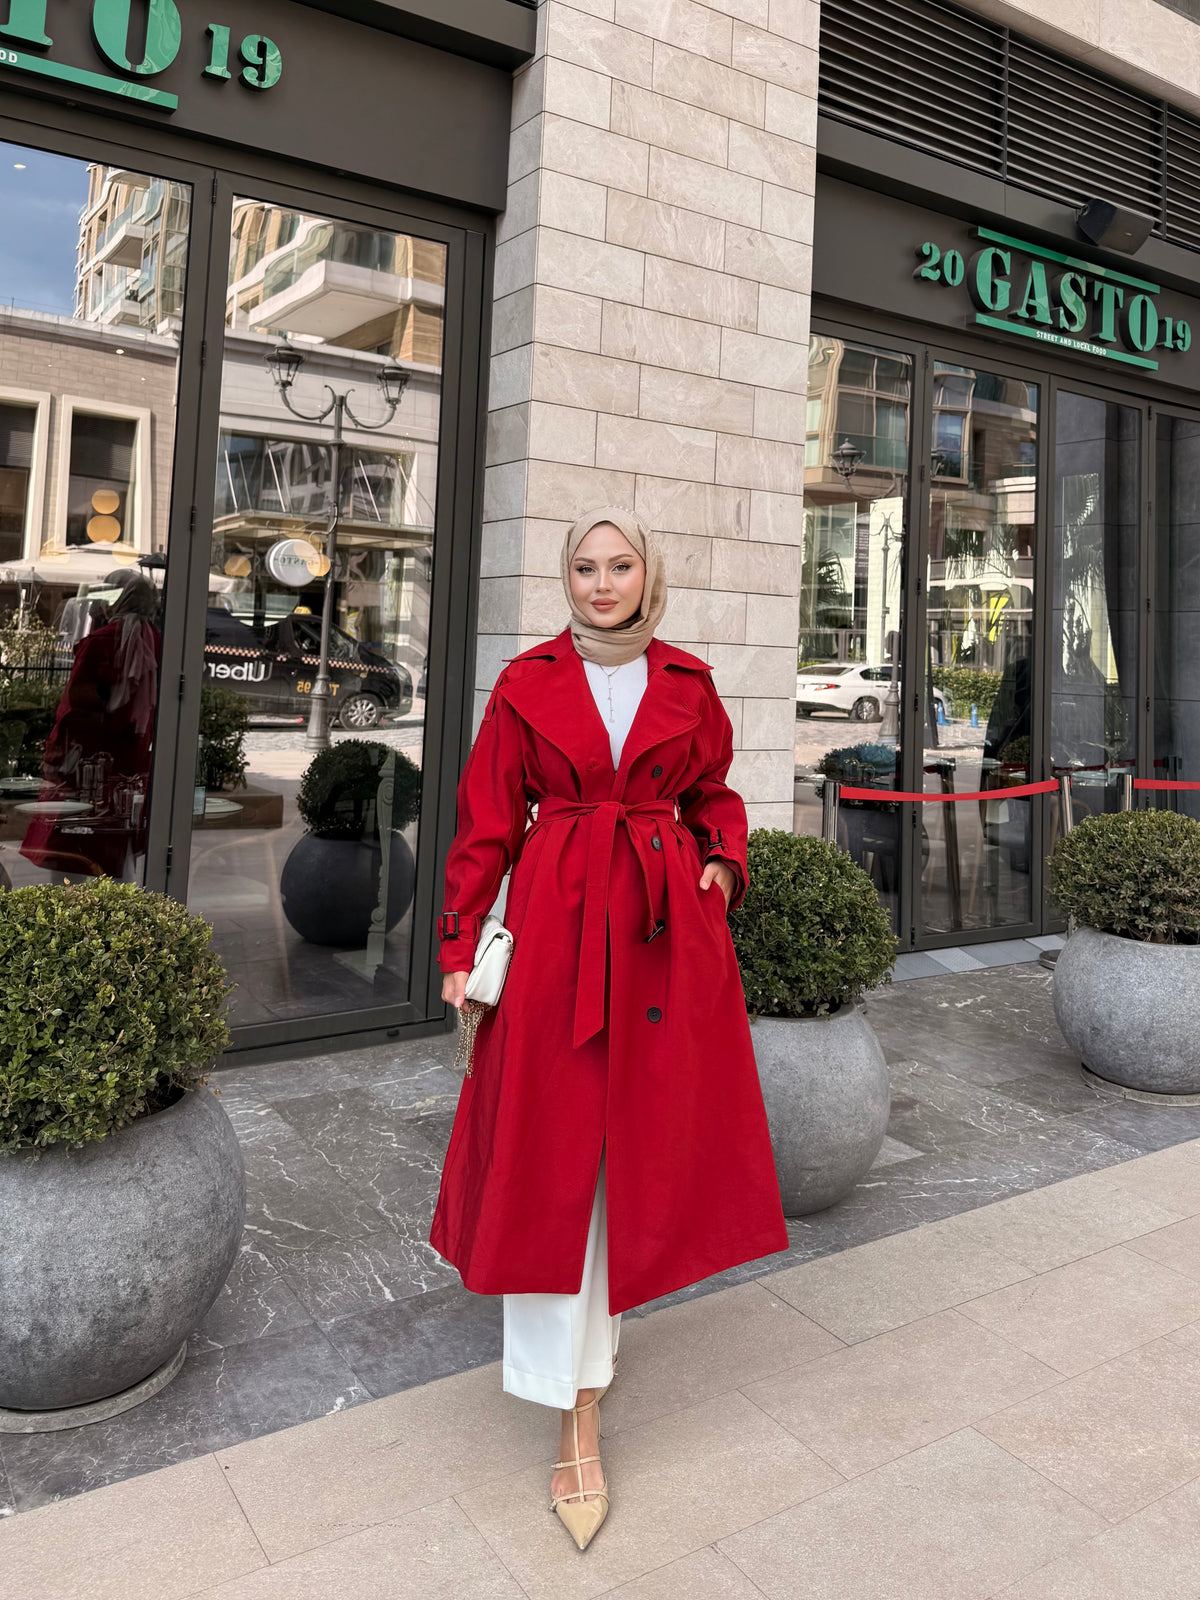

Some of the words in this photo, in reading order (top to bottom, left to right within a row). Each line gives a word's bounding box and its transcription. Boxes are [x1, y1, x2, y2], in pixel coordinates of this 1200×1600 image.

[203, 23, 282, 89] 19
[920, 242, 965, 287] 20
[976, 247, 1159, 352] GASTO
[1163, 317, 1192, 352] 19
[1036, 330, 1058, 342] STREET
[1060, 336, 1072, 346] AND
[1073, 341, 1091, 352] LOCAL
[1092, 345, 1107, 356] FOOD
